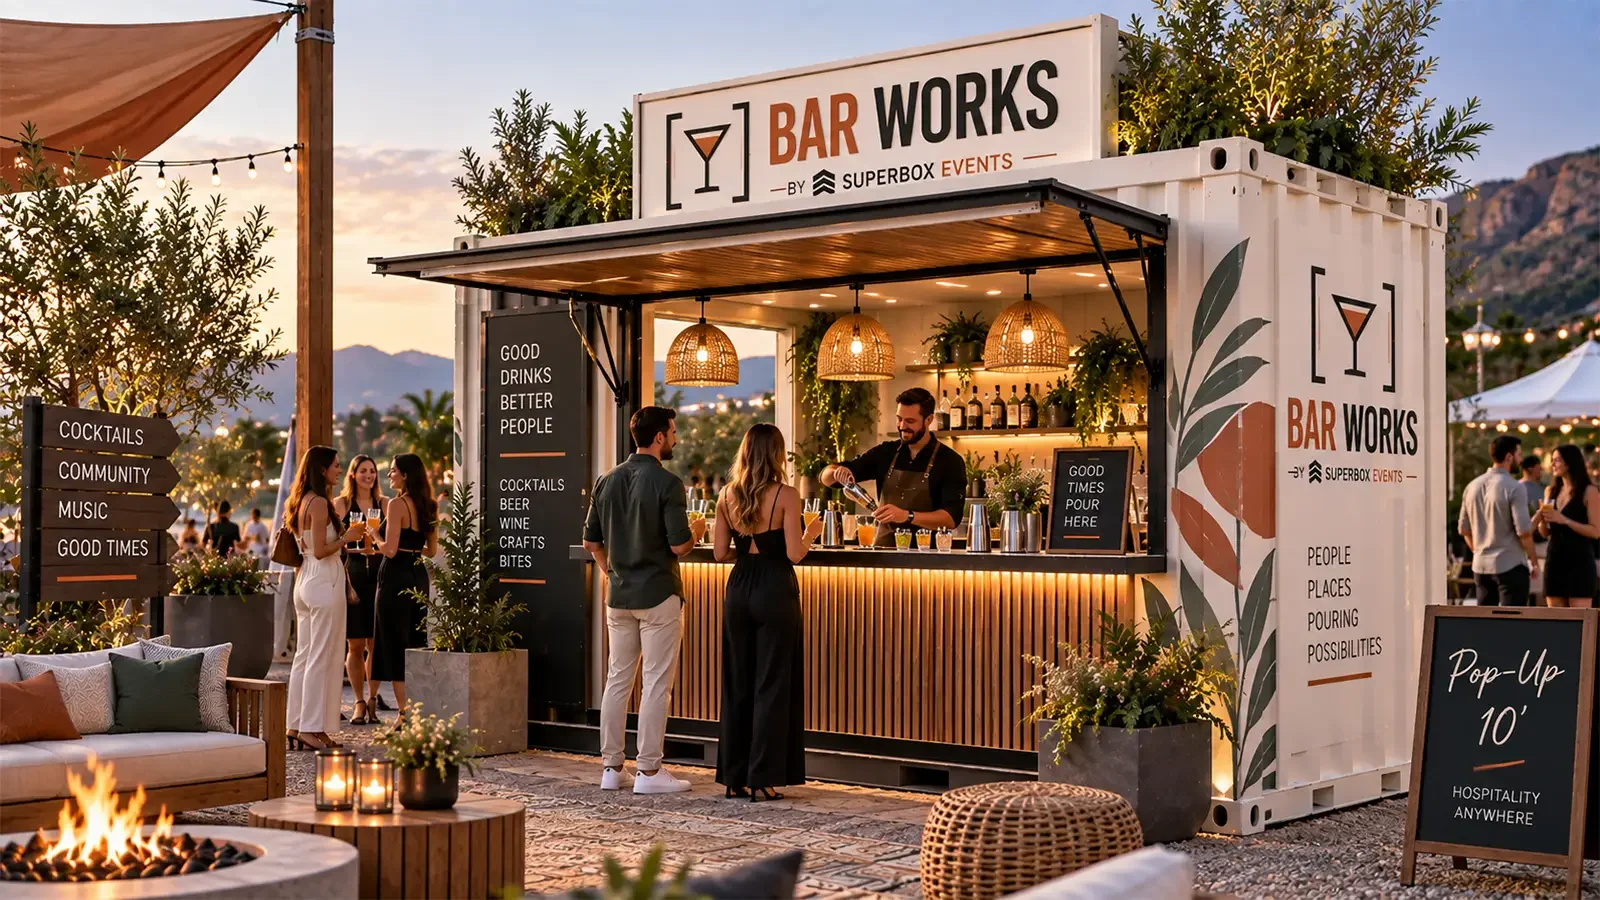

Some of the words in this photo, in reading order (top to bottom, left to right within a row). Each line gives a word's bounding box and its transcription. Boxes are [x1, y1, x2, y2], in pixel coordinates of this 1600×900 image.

[769, 92, 859, 165] BAR
[874, 59, 1058, 150] WORKS
[787, 179, 805, 196] BY
[842, 162, 935, 190] SUPERBOX
[941, 152, 1013, 178] EVENTS
[500, 343, 540, 361] GOOD
[500, 367, 552, 385] DRINKS
[500, 392, 553, 410] BETTER
[59, 420, 144, 446] COCKTAILS
[500, 417, 553, 435] PEOPLE
[1287, 396, 1336, 451] BAR
[1343, 403, 1418, 456] WORKS
[58, 461, 151, 484] COMMUNITY
[1069, 465, 1105, 477] GOOD
[1325, 467, 1370, 481] SUPERBOX
[1373, 468, 1403, 483] EVENTS
[500, 478, 565, 492] COCKTAILS
[1067, 482, 1105, 494] TIMES
[58, 501, 108, 520] MUSIC
[500, 497, 530, 511] BEER
[1065, 499, 1099, 511] POUR
[499, 517, 530, 530] WINE
[1064, 515, 1098, 528] HERE
[57, 539, 101, 557] GOOD
[107, 539, 149, 557] TIMES
[499, 535, 545, 550] CRAFTS
[499, 555, 532, 568] BITES
[1308, 545, 1351, 566] PEOPLE
[1308, 577, 1351, 599] PLACES
[1308, 608, 1359, 632] POURING
[1308, 636, 1382, 664] POSSIBILITIES
[1448, 648, 1565, 699] Pop-Up
[1452, 785, 1541, 805] HOSPITALITY
[1453, 806, 1534, 826] ANYWHERE
